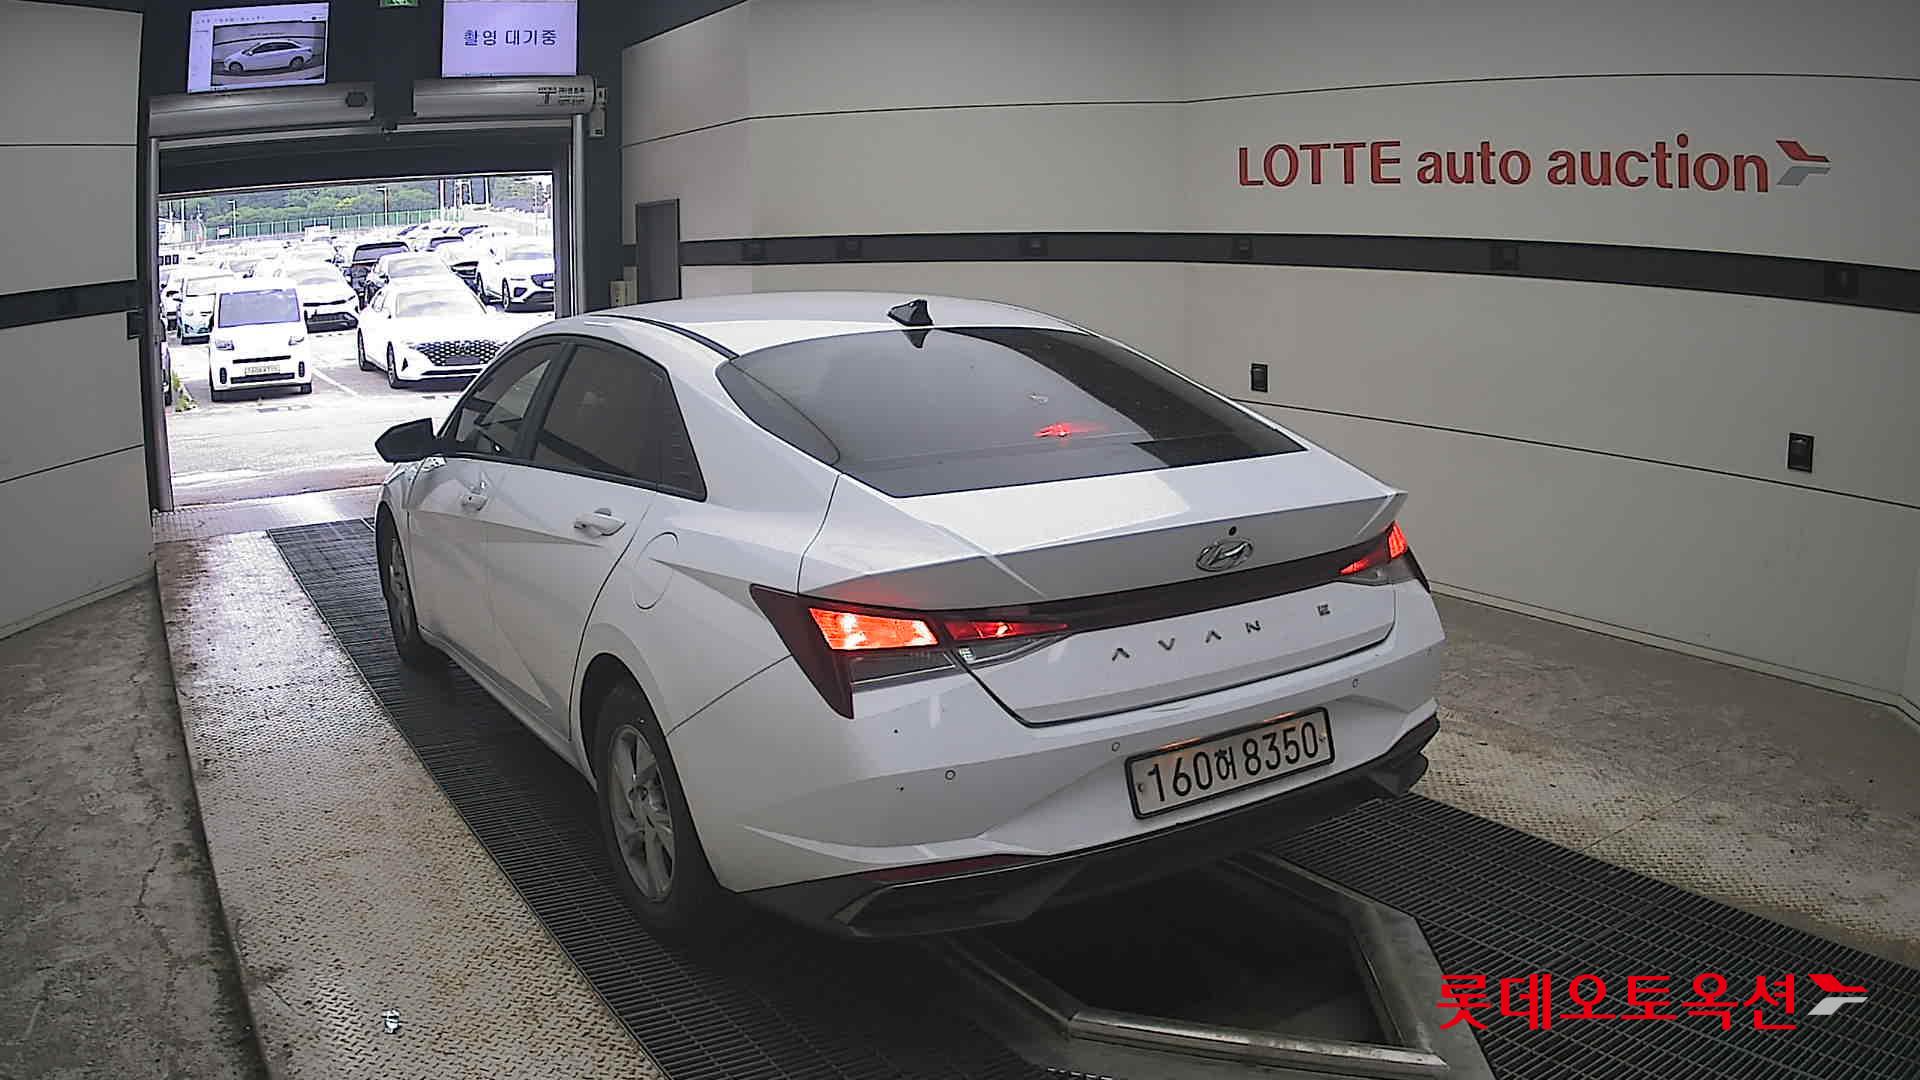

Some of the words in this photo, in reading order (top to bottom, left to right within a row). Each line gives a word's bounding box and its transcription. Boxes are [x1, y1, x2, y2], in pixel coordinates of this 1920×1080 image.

[505, 29, 557, 46] 대기중
[1238, 140, 1401, 187] LOTTE
[1416, 140, 1532, 186] auto
[1547, 132, 1769, 193] auction
[1242, 721, 1319, 776] 8350
